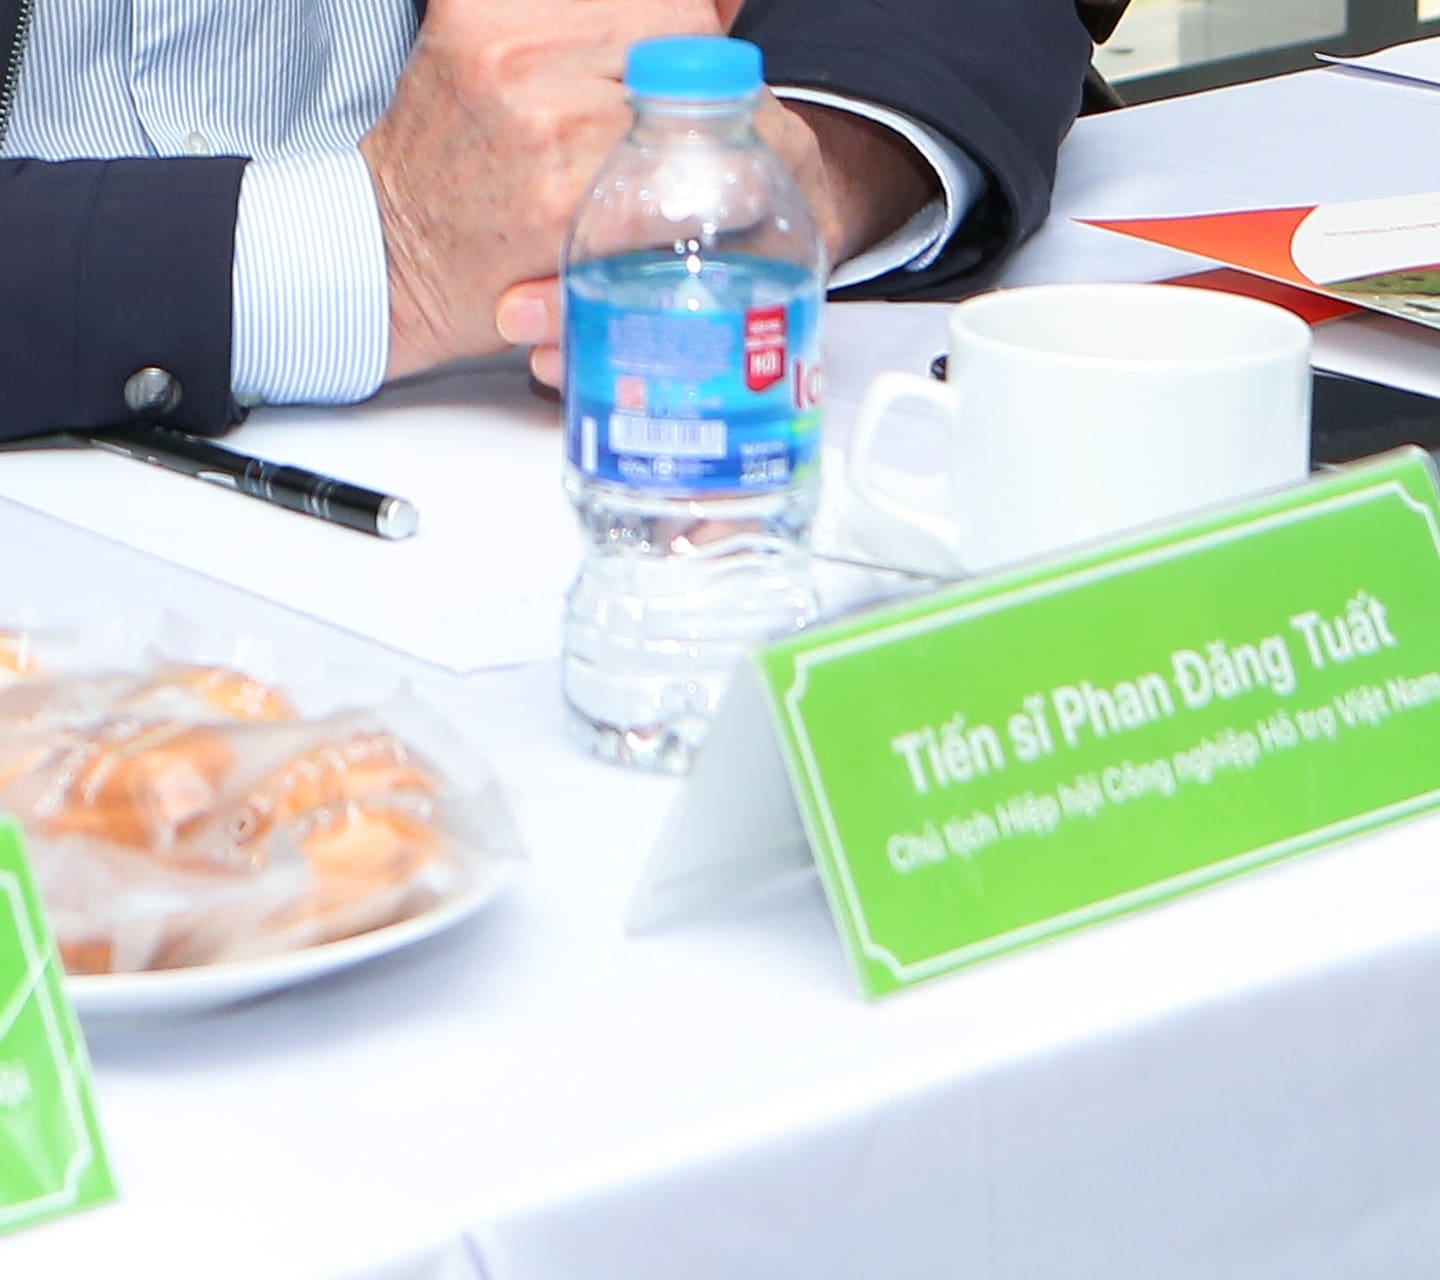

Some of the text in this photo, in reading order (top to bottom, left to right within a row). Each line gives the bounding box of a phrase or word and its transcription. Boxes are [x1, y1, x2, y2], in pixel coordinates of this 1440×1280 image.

[890, 588, 1398, 796] Tiến sĩ Phan Đăng Tuất
[1101, 757, 1177, 804] Công
[1332, 684, 1391, 728] Việt
